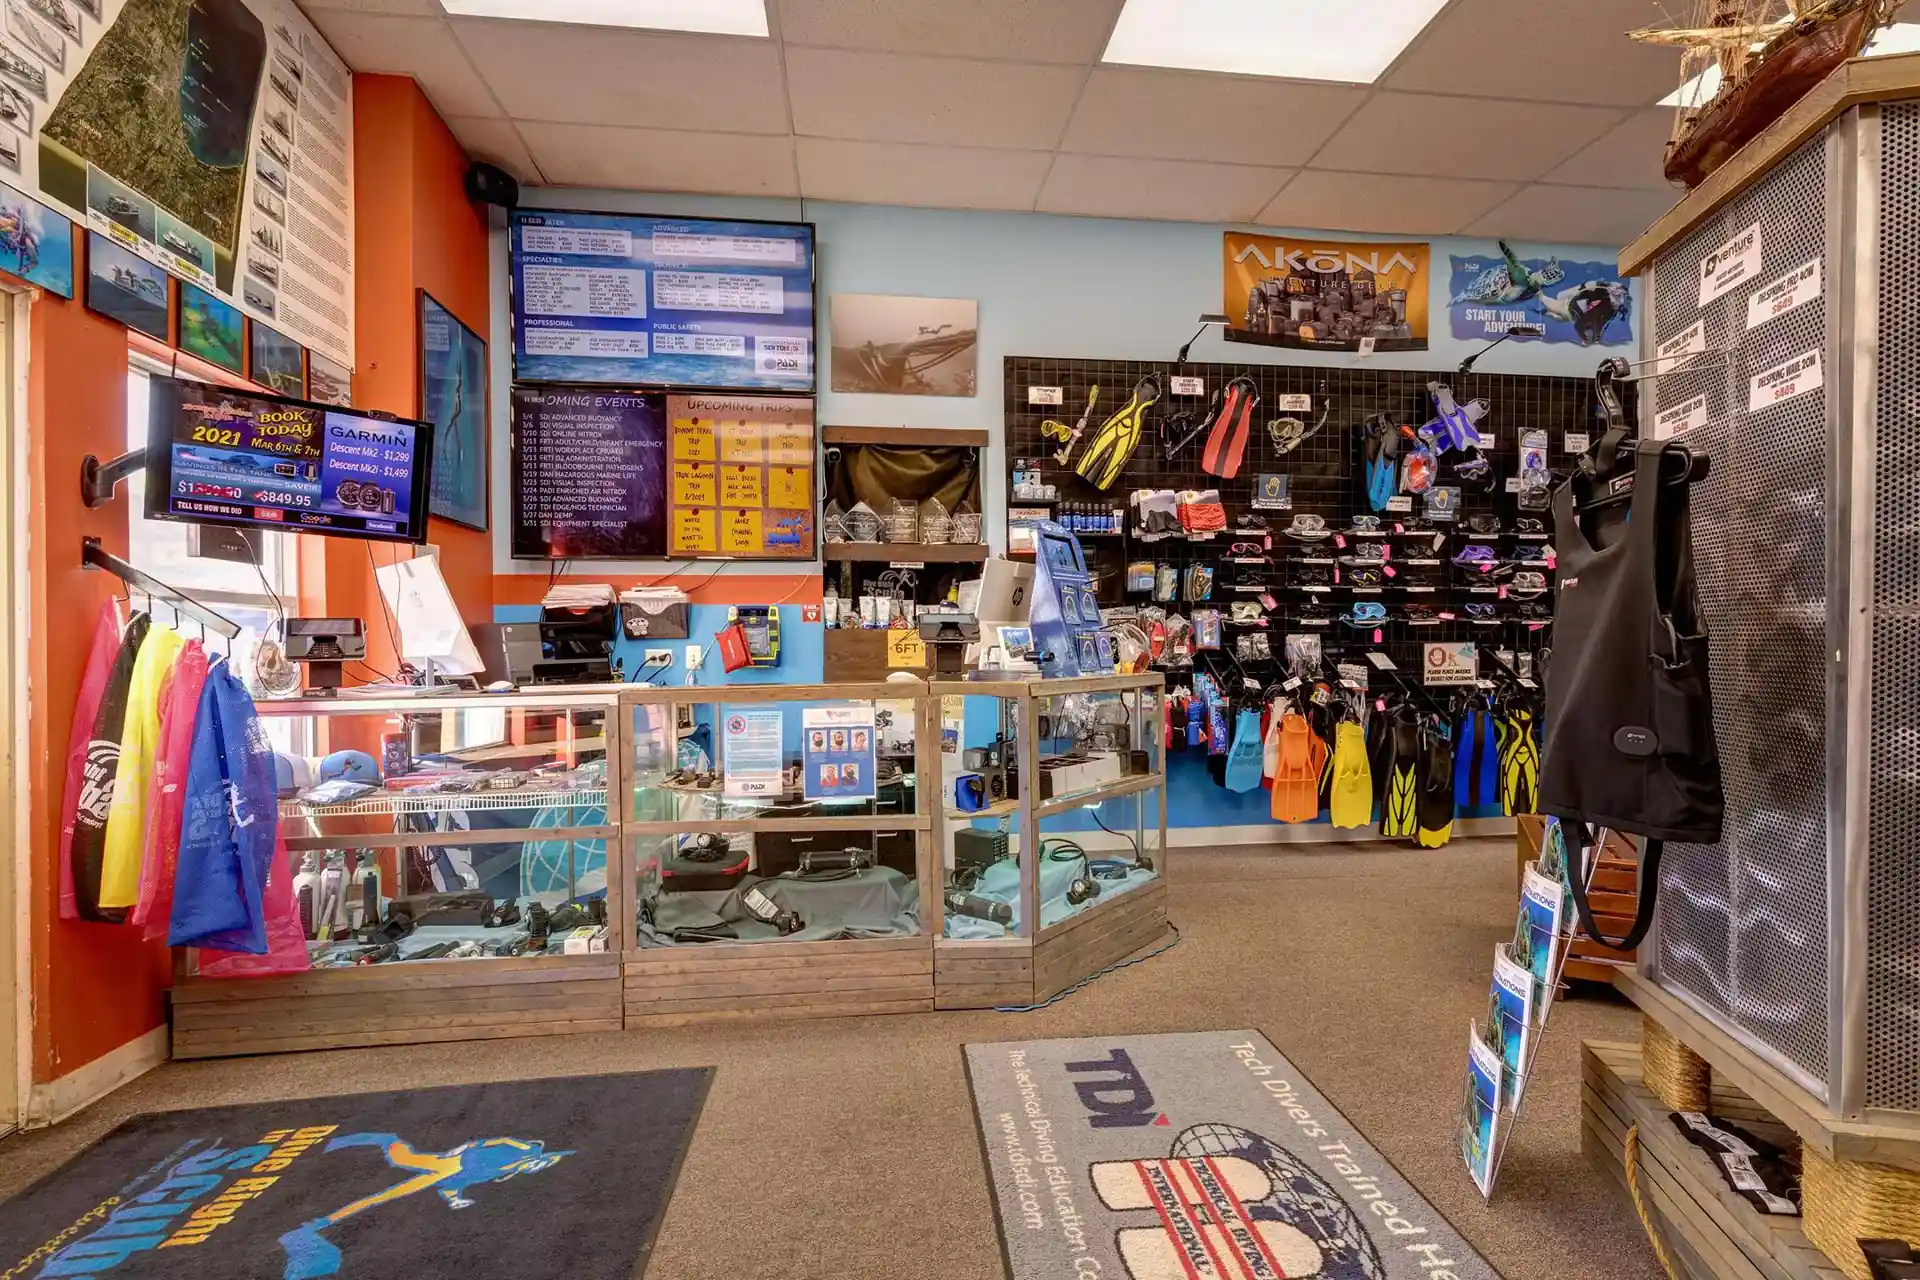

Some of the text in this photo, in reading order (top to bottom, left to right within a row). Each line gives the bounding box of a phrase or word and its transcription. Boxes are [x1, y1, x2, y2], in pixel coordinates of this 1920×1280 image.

[1717, 233, 1753, 264] venture
[522, 256, 562, 264] SPECIALTIES
[524, 318, 574, 327] PROFESSIONAL
[1466, 309, 1525, 322] START YOUR
[776, 360, 798, 368] PADI
[595, 397, 644, 408] EVENTS
[688, 400, 794, 412] UPCOMING TRIPS
[260, 410, 308, 423] BOOK
[192, 426, 241, 448] 2021
[258, 424, 312, 437] TODAY
[330, 426, 407, 448] GARMIN
[330, 442, 410, 462] Descent Mk2 $1,299
[330, 458, 359, 472] Descent
[384, 466, 408, 478] $1,499
[606, 464, 644, 472] PATHOGENS
[177, 501, 192, 510] TELL
[204, 504, 219, 512] HOW
[220, 506, 230, 514] WE
[231, 506, 242, 514] DID
[261, 490, 311, 506] $849.95
[588, 504, 626, 512] TECHNICIAN
[301, 513, 332, 524] Google
[368, 522, 394, 530] facebook
[896, 644, 918, 654] 6FT
[1007, 1049, 1027, 1070] The
[1012, 1068, 1047, 1119] Technical
[1065, 1048, 1171, 1128] TDI
[251, 1124, 339, 1174] Dive
[1029, 1118, 1060, 1164] Diving
[1229, 1041, 1272, 1082] Tech
[1261, 1076, 1327, 1138] Divers
[1318, 1141, 1428, 1237] Trained
[998, 1110, 1045, 1231] www.tdisdi.com
[33, 1144, 272, 1280] Scub
[158, 1177, 281, 1250] Right
[1043, 1165, 1092, 1254] Education
[1190, 1157, 1274, 1280] TECHNICAL DIVING
[1145, 1166, 1213, 1276] INTERNATIONAL
[0, 1195, 121, 1280] adventur
